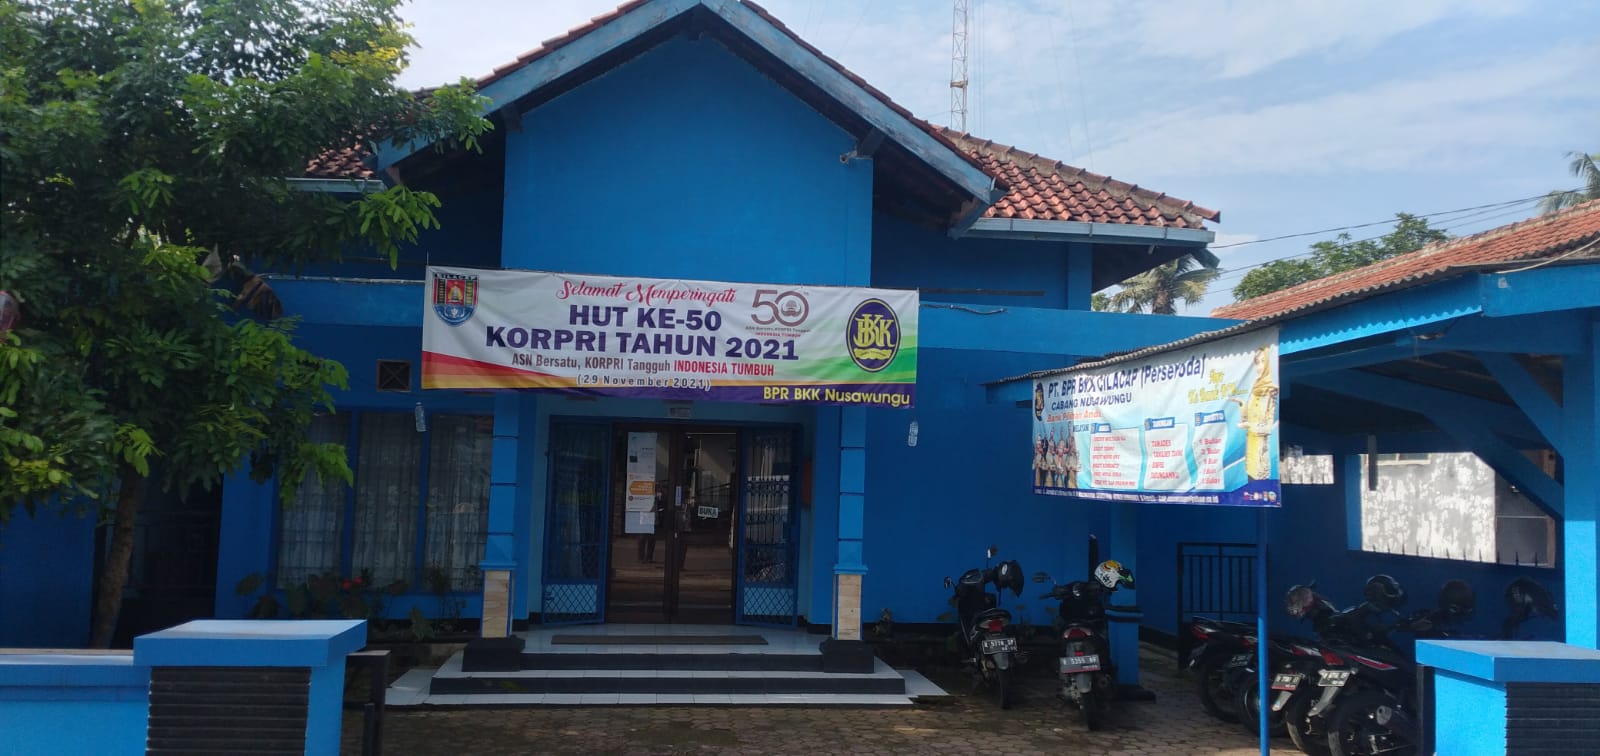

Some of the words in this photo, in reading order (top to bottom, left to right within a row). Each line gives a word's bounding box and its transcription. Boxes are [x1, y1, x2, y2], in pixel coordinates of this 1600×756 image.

[556, 280, 625, 300] Selamat
[625, 285, 736, 306] Memperingati
[570, 304, 628, 327] HUT
[637, 307, 722, 331] KE-50
[486, 326, 606, 352] KORPRI
[616, 332, 716, 357] TAHUN
[725, 338, 799, 360] 2021
[512, 353, 533, 366] ASN
[536, 354, 581, 370] Bersatu,
[585, 356, 624, 370] KORPRI
[628, 358, 670, 374] Tangguh
[673, 361, 728, 374] INDONESIA
[731, 362, 774, 376] TUMBUH
[1061, 378, 1076, 397] BPR
[1097, 367, 1141, 392] CILACAP
[1141, 355, 1207, 389] (Perseroda)
[577, 374, 598, 386] (29
[603, 375, 668, 387] November
[672, 377, 711, 391] 2021)
[763, 387, 789, 400] BPR
[794, 388, 820, 401] BKK
[825, 390, 910, 405] Nusawungu
[1051, 398, 1078, 411] CABANG
[1079, 392, 1132, 408] NUSAWUNGU
[699, 507, 717, 518] BUKA
